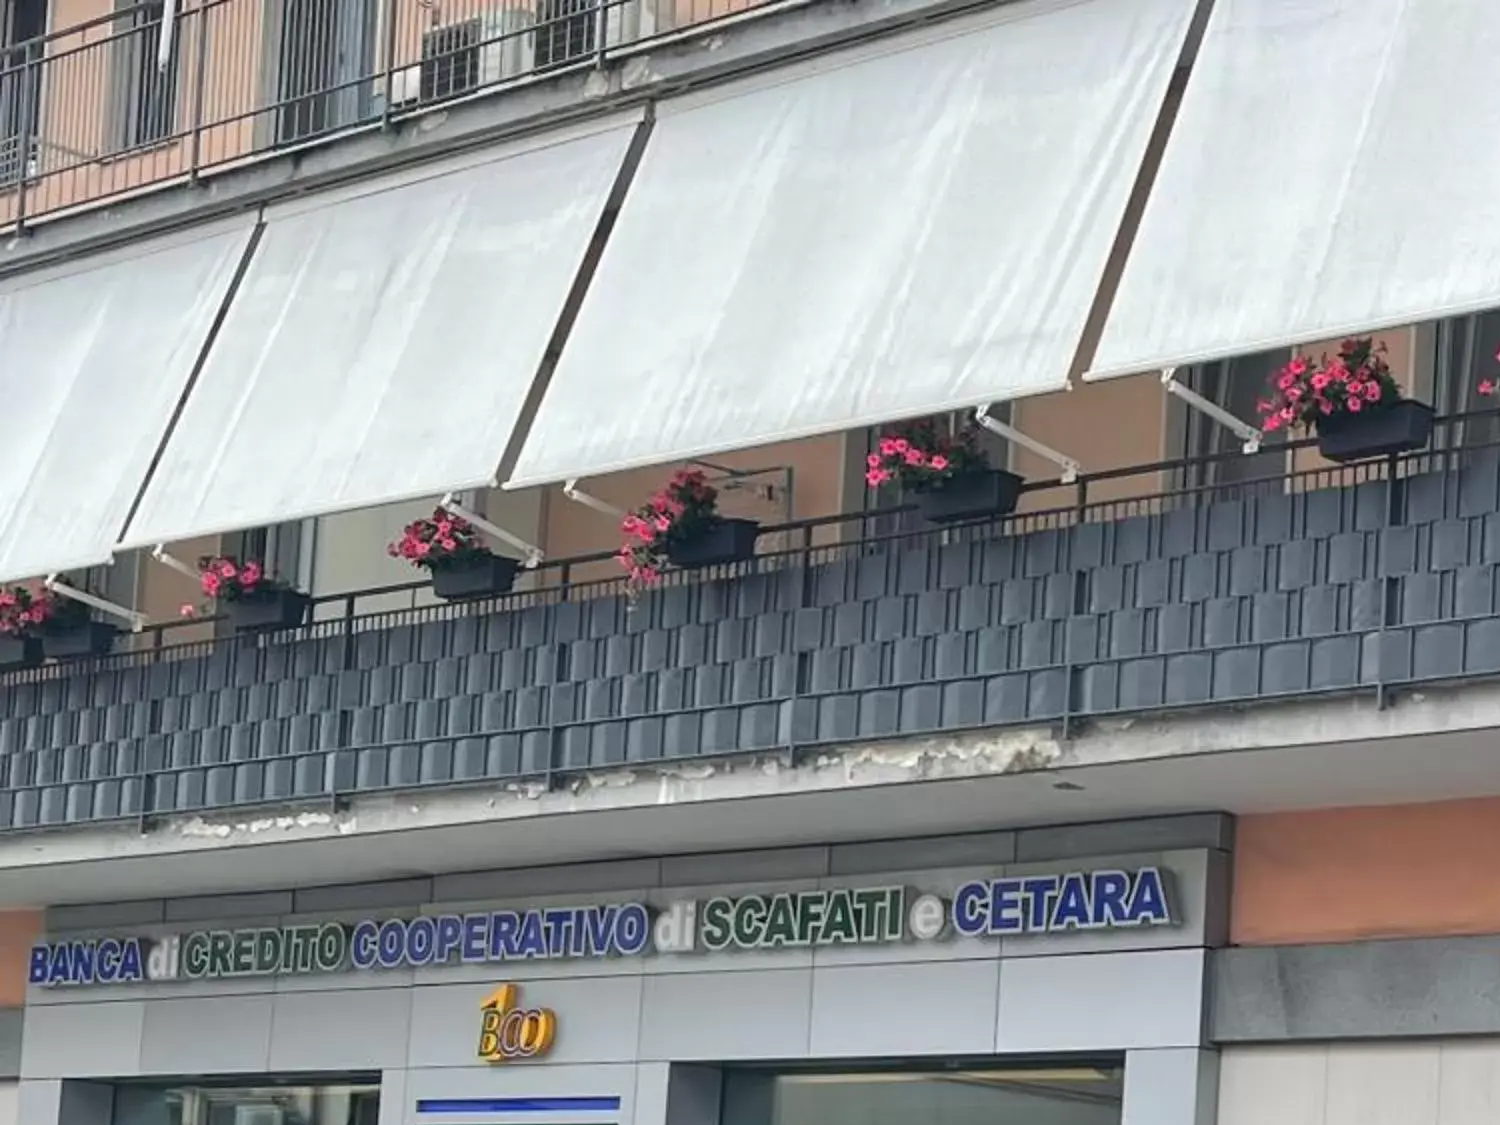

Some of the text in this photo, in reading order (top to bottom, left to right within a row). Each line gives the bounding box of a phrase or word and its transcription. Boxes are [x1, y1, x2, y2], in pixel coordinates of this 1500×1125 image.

[28, 867, 1170, 985] BANCA di CREDITO COOPERATIVO di SCAFATI e CETARA
